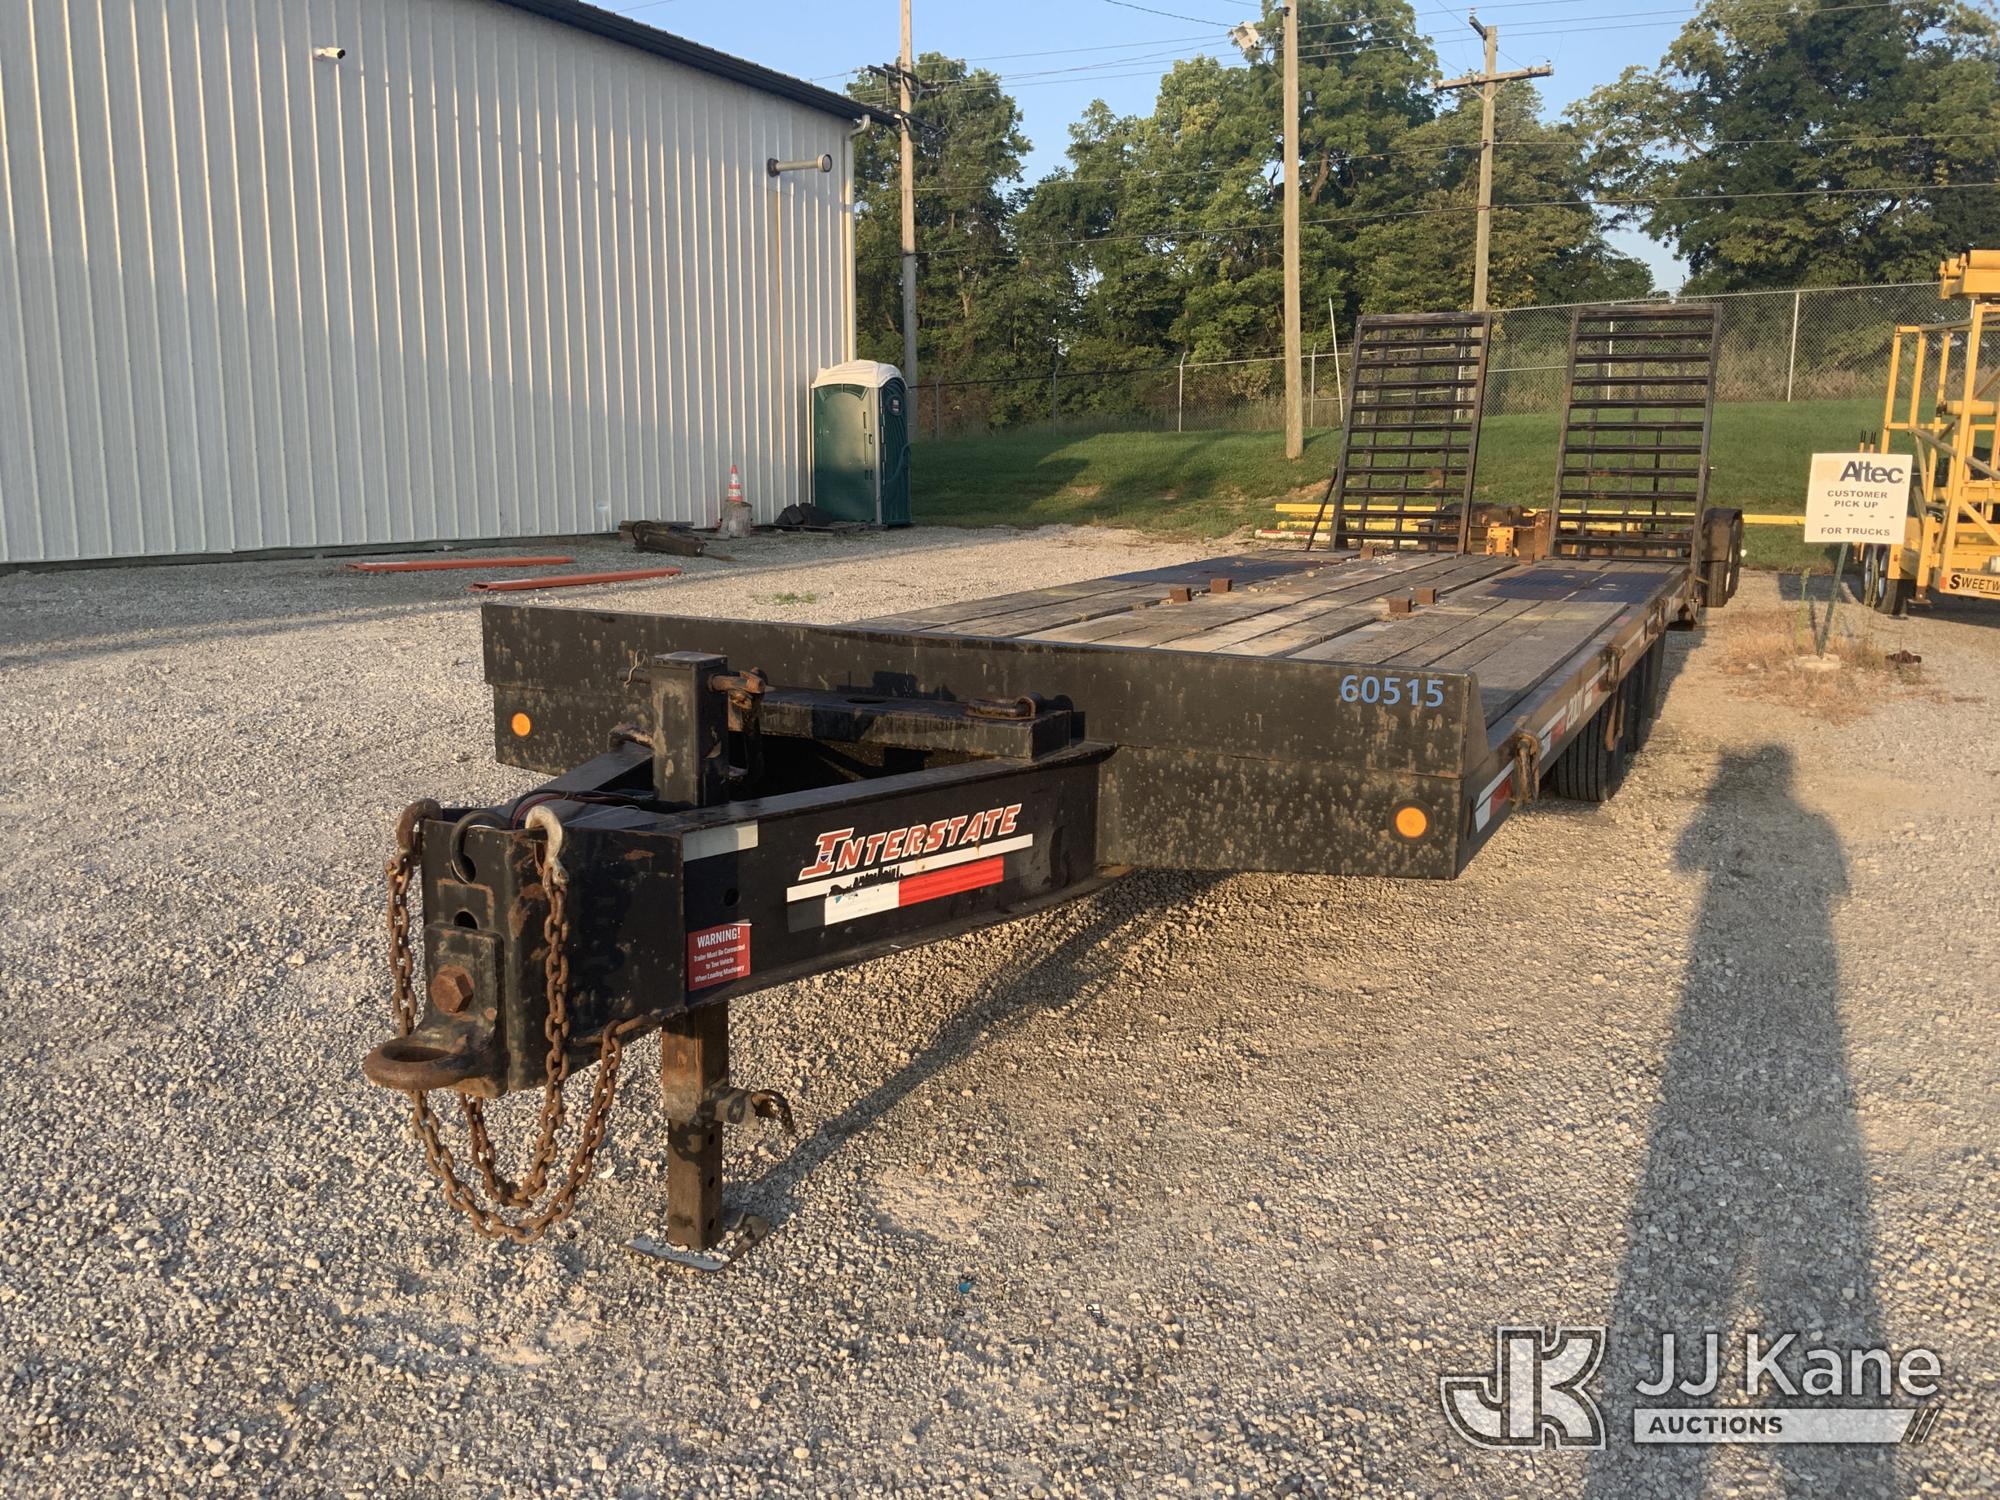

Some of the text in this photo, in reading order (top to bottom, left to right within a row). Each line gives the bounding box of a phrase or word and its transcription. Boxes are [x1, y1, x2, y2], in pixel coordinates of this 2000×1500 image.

[1839, 460, 1904, 484] Altec
[1827, 489, 1888, 499] CUSTOMER
[1834, 499, 1879, 509] PICK UP
[1820, 526, 1891, 537] FOR TRUCKS
[1340, 674, 1445, 708] 60515
[798, 803, 1023, 881] INTERSTATE
[697, 926, 741, 949] WARNING!
[706, 951, 718, 959] Must
[724, 944, 746, 954] Connected
[719, 957, 735, 966] Vehicle
[695, 965, 745, 983] When Loading Machinery
